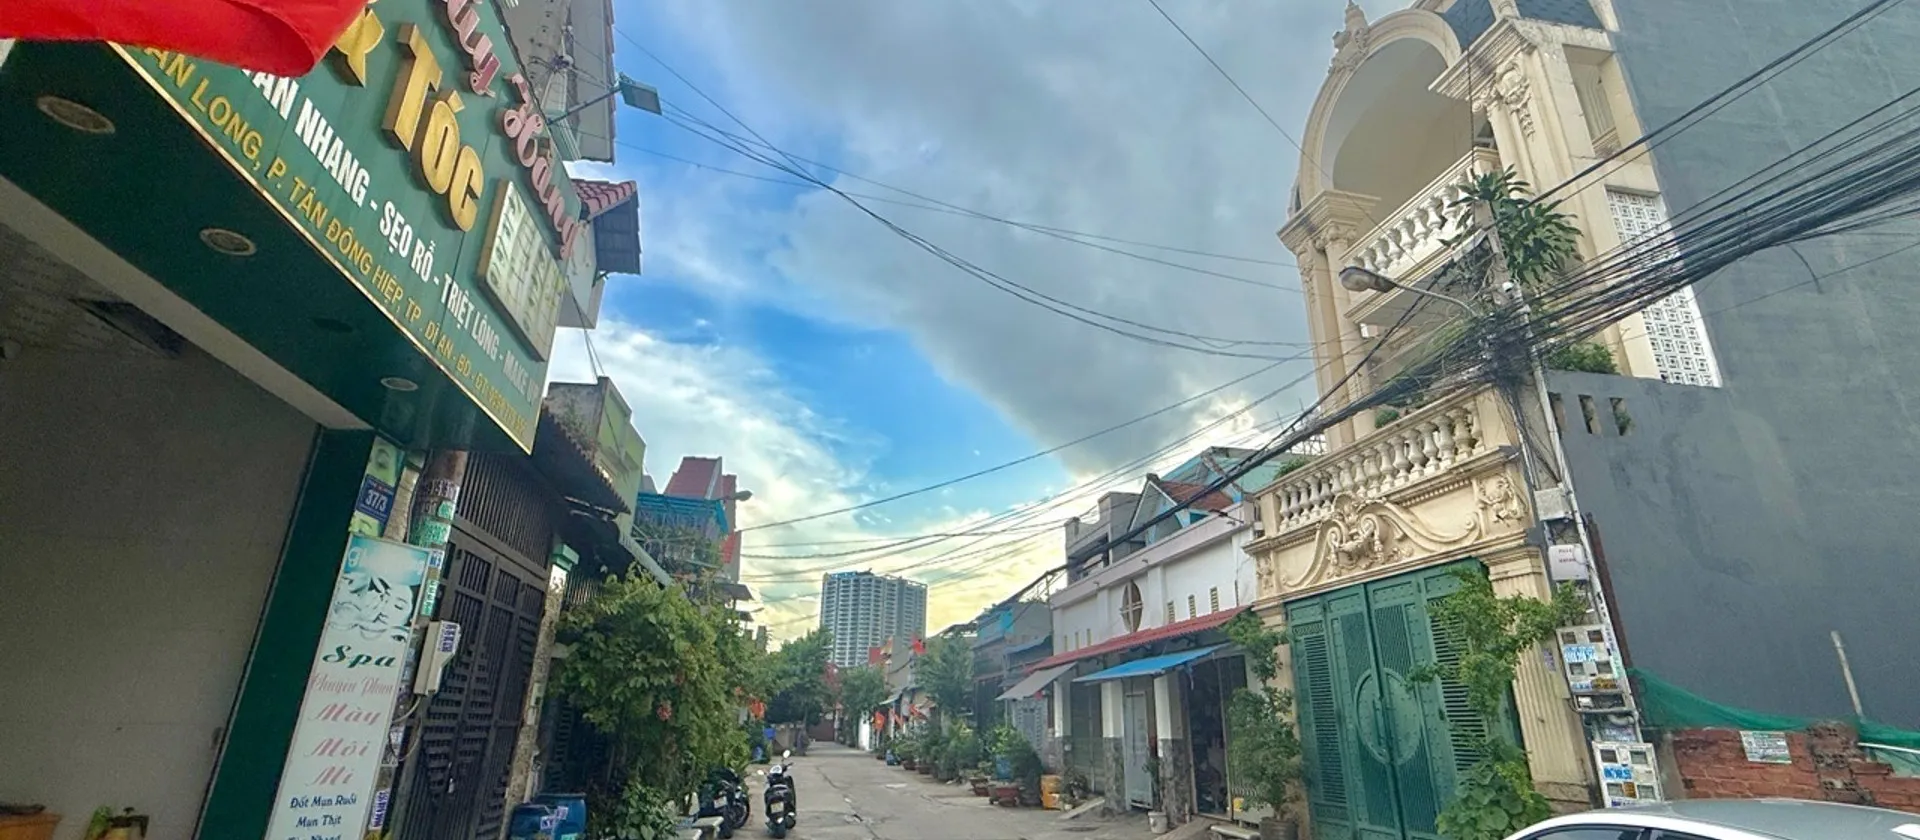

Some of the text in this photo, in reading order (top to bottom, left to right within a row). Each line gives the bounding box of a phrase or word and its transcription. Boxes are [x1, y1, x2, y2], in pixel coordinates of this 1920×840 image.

[394, 24, 484, 232] Tóc
[190, 78, 263, 171] LONG,
[266, 157, 287, 189] P.
[290, 177, 328, 229] TÂN
[326, 218, 373, 275] ĐÔNG
[372, 264, 404, 314] HIỆP,
[437, 334, 454, 360] AN
[294, 98, 370, 208] NHANG
[370, 199, 378, 211] -
[380, 201, 413, 258] SẸO
[411, 240, 437, 283] RỖ
[441, 273, 475, 330] TRIỆT
[471, 311, 500, 361] LÔNG
[365, 490, 388, 511] 37/3
[322, 644, 396, 669] Spa
[305, 738, 369, 758] Môi
[290, 795, 309, 809] Đốt
[311, 796, 333, 810] Mụn
